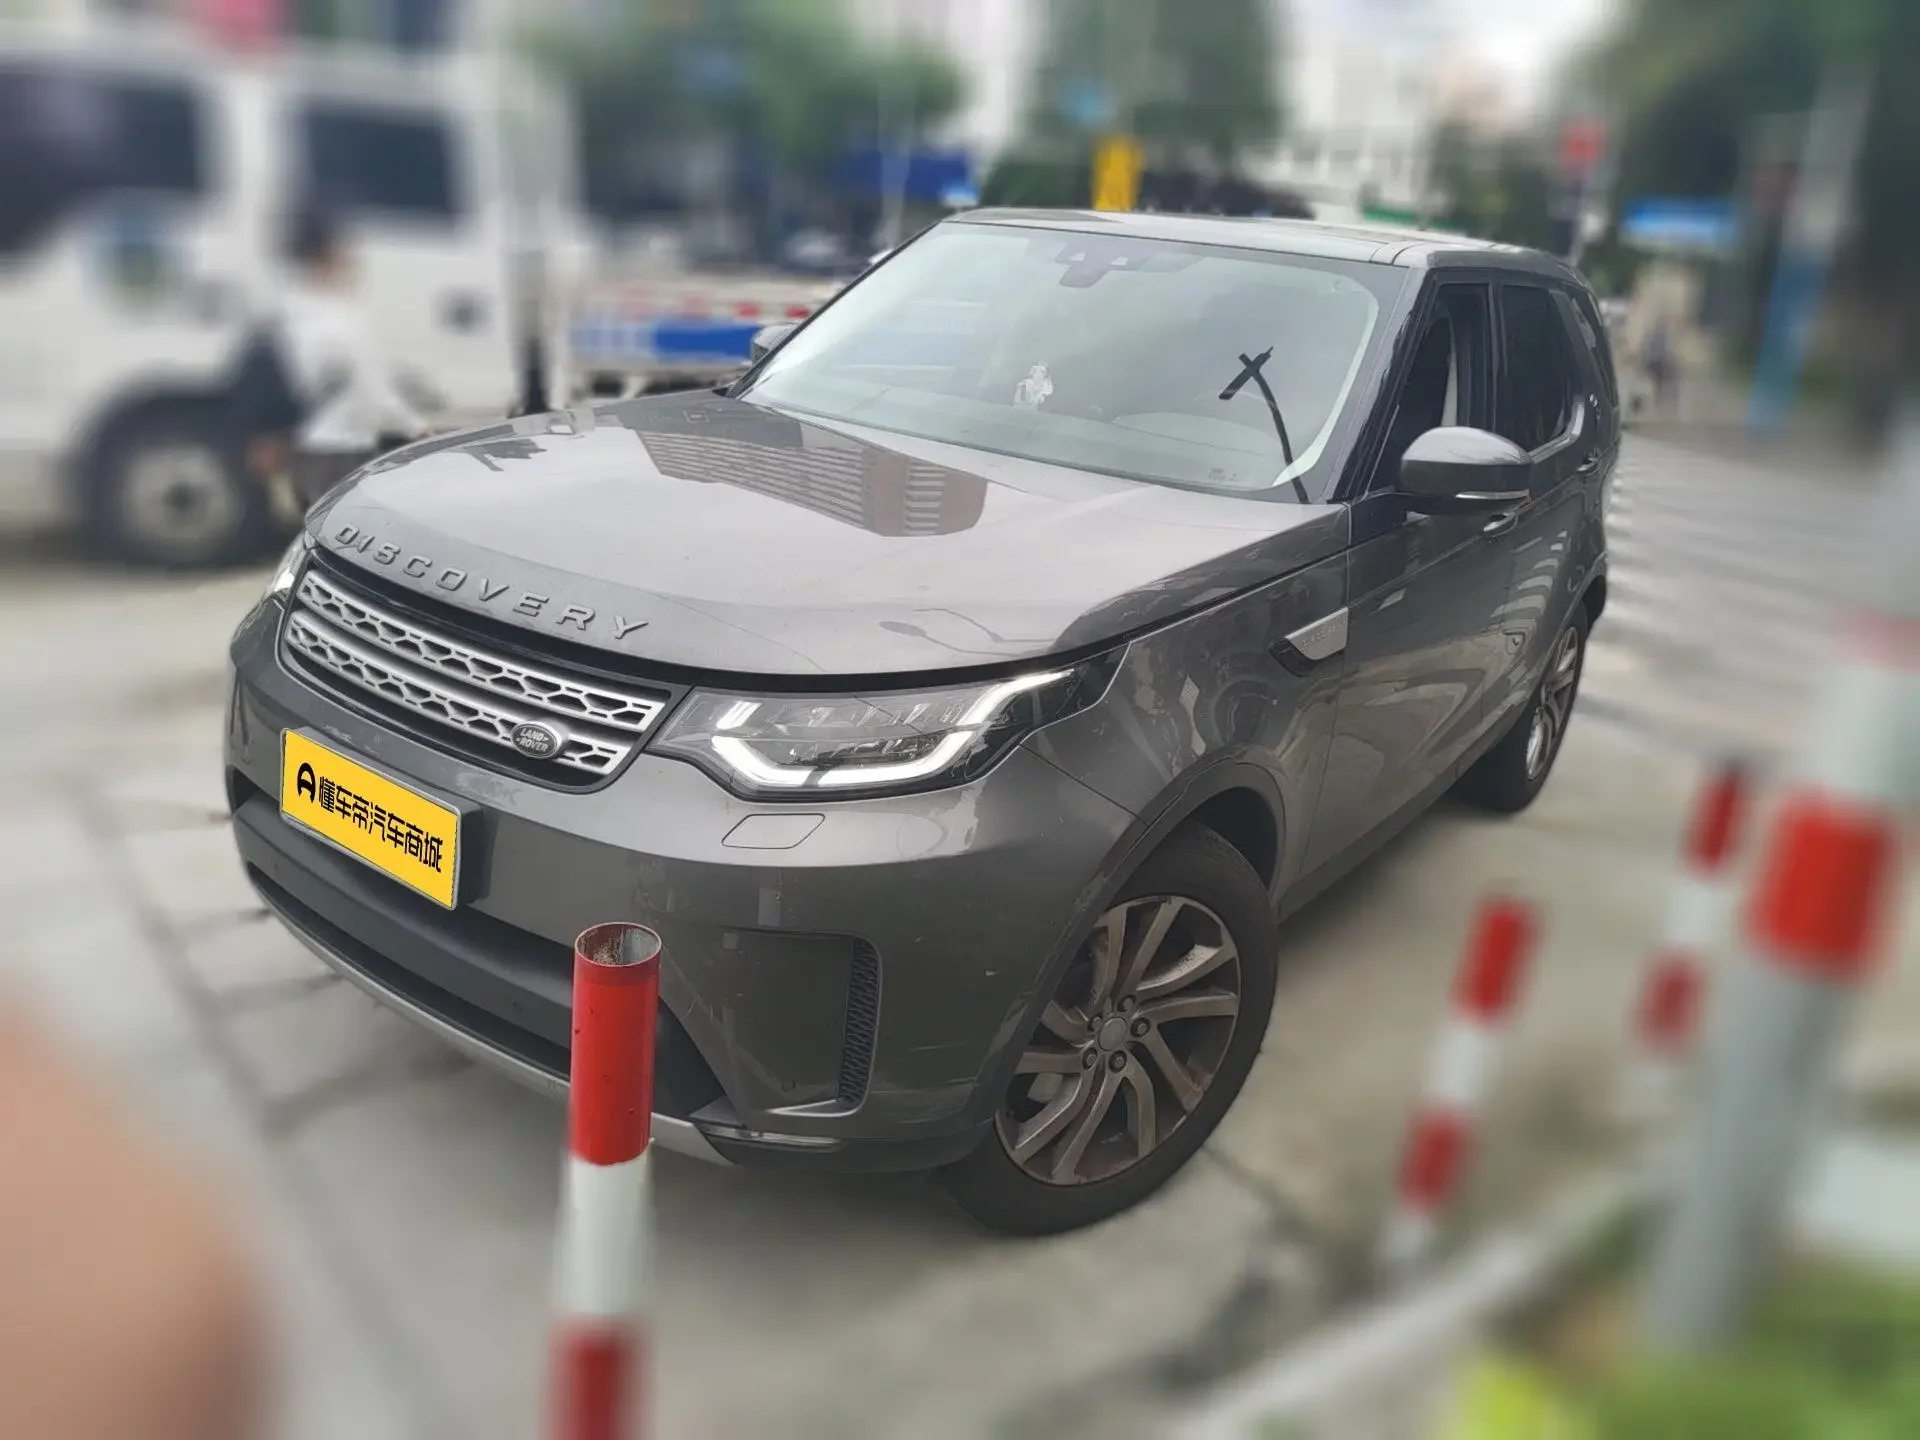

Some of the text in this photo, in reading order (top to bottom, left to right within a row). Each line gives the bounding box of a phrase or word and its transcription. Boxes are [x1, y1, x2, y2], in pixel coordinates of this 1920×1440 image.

[335, 523, 649, 639] DISCOVERY
[520, 728, 545, 741] LAND
[519, 737, 549, 752] ROVER
